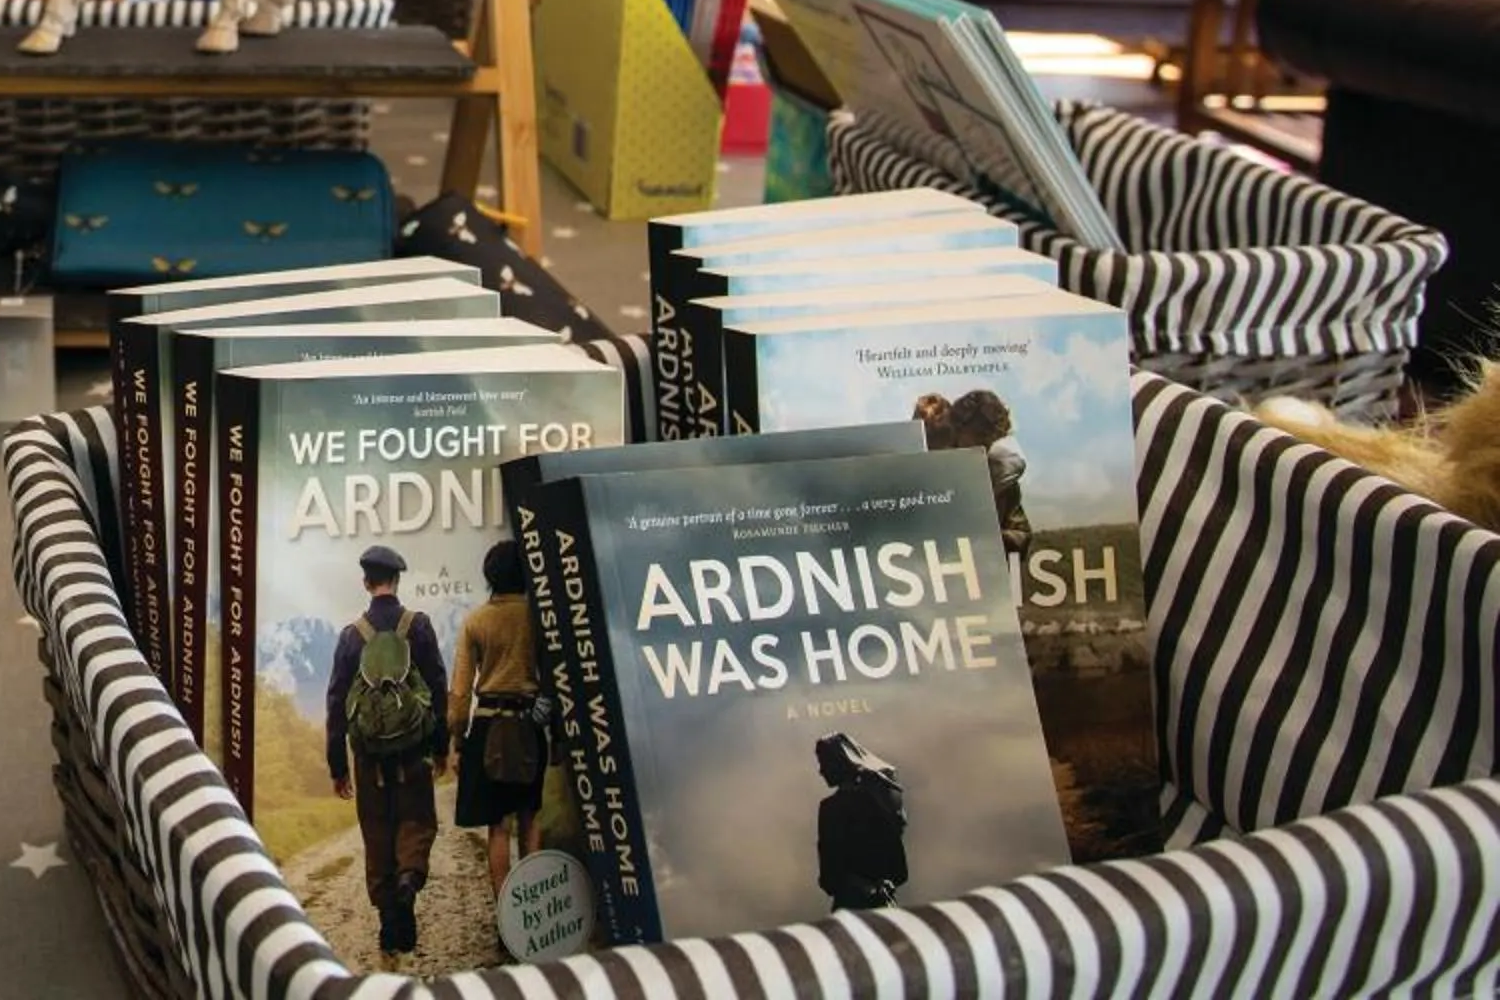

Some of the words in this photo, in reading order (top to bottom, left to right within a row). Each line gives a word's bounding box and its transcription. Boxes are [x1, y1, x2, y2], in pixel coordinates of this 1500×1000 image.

[655, 293, 681, 441] ARDNIS
[915, 345, 937, 360] and
[940, 343, 978, 360] deeply
[132, 368, 147, 405] WE
[184, 380, 198, 418] WE
[135, 412, 154, 510] FOUGHT
[228, 423, 244, 463] WE
[288, 430, 345, 466] WE
[357, 425, 507, 462] FOUGHT
[518, 421, 593, 455] FOR
[183, 426, 198, 529] FOUGHT
[228, 472, 244, 577] FOUGHT
[287, 466, 505, 541] ARDNI
[725, 507, 736, 525] of
[747, 506, 772, 520] time
[773, 507, 798, 521] gone
[799, 501, 839, 518] forever
[870, 498, 896, 511] very
[899, 491, 925, 510] good
[141, 519, 156, 565] FOR
[182, 537, 196, 586] FOR
[414, 581, 474, 598] NOVEL
[438, 566, 450, 578] A
[635, 536, 982, 632] ARDNISH
[229, 586, 244, 638] FOR
[181, 595, 195, 705] ARDNISH
[642, 633, 789, 699] WAS
[799, 614, 998, 685] HOME
[230, 646, 244, 759] ARDNISH
[516, 505, 563, 652] ARDNISH
[552, 660, 581, 739] WAS
[570, 749, 605, 854] HOME
[555, 528, 600, 683] ARDNISH
[587, 694, 617, 775] WAS
[603, 786, 640, 898] HOME
[806, 698, 873, 718] NOVEL
[510, 863, 570, 909] Signed
[521, 907, 544, 932] by
[546, 892, 573, 917] the
[524, 915, 585, 958] Author
